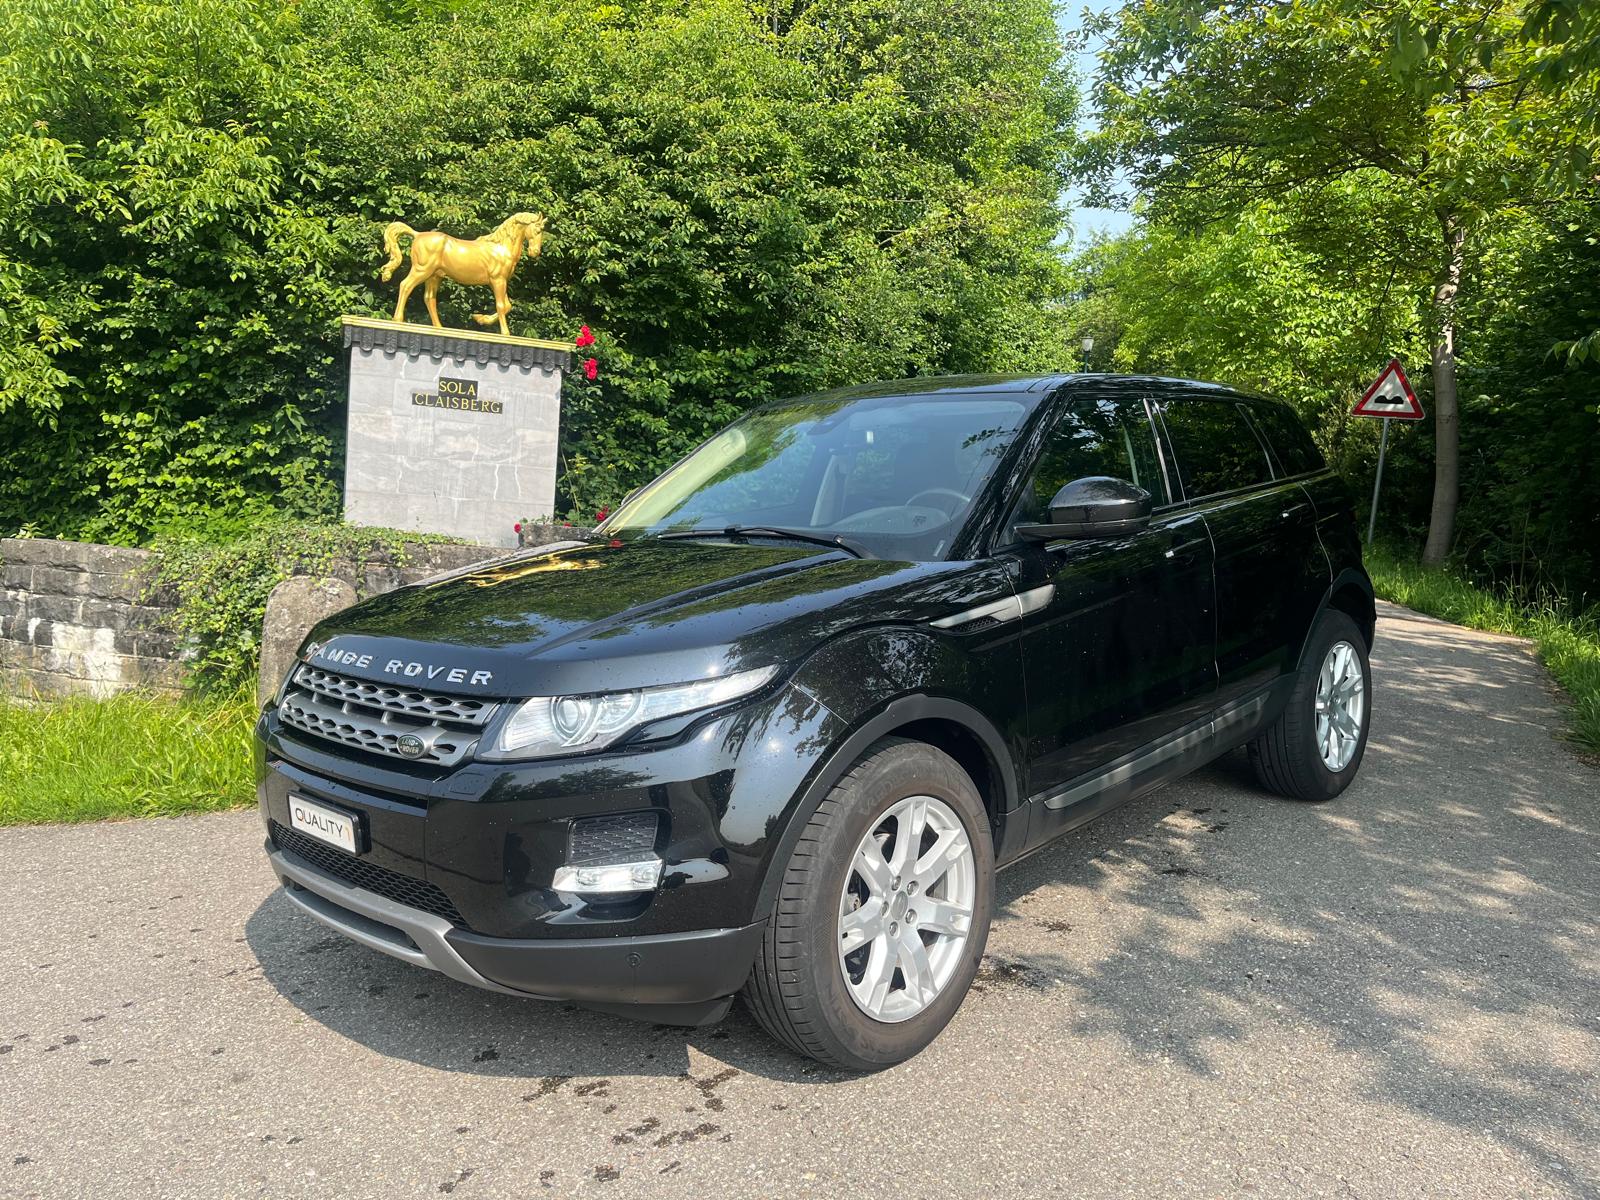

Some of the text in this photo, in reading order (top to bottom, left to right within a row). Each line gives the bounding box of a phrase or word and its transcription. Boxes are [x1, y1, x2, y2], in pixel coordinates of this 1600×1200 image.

[438, 380, 477, 396] SOLA
[306, 641, 493, 686] RANGE ROVER
